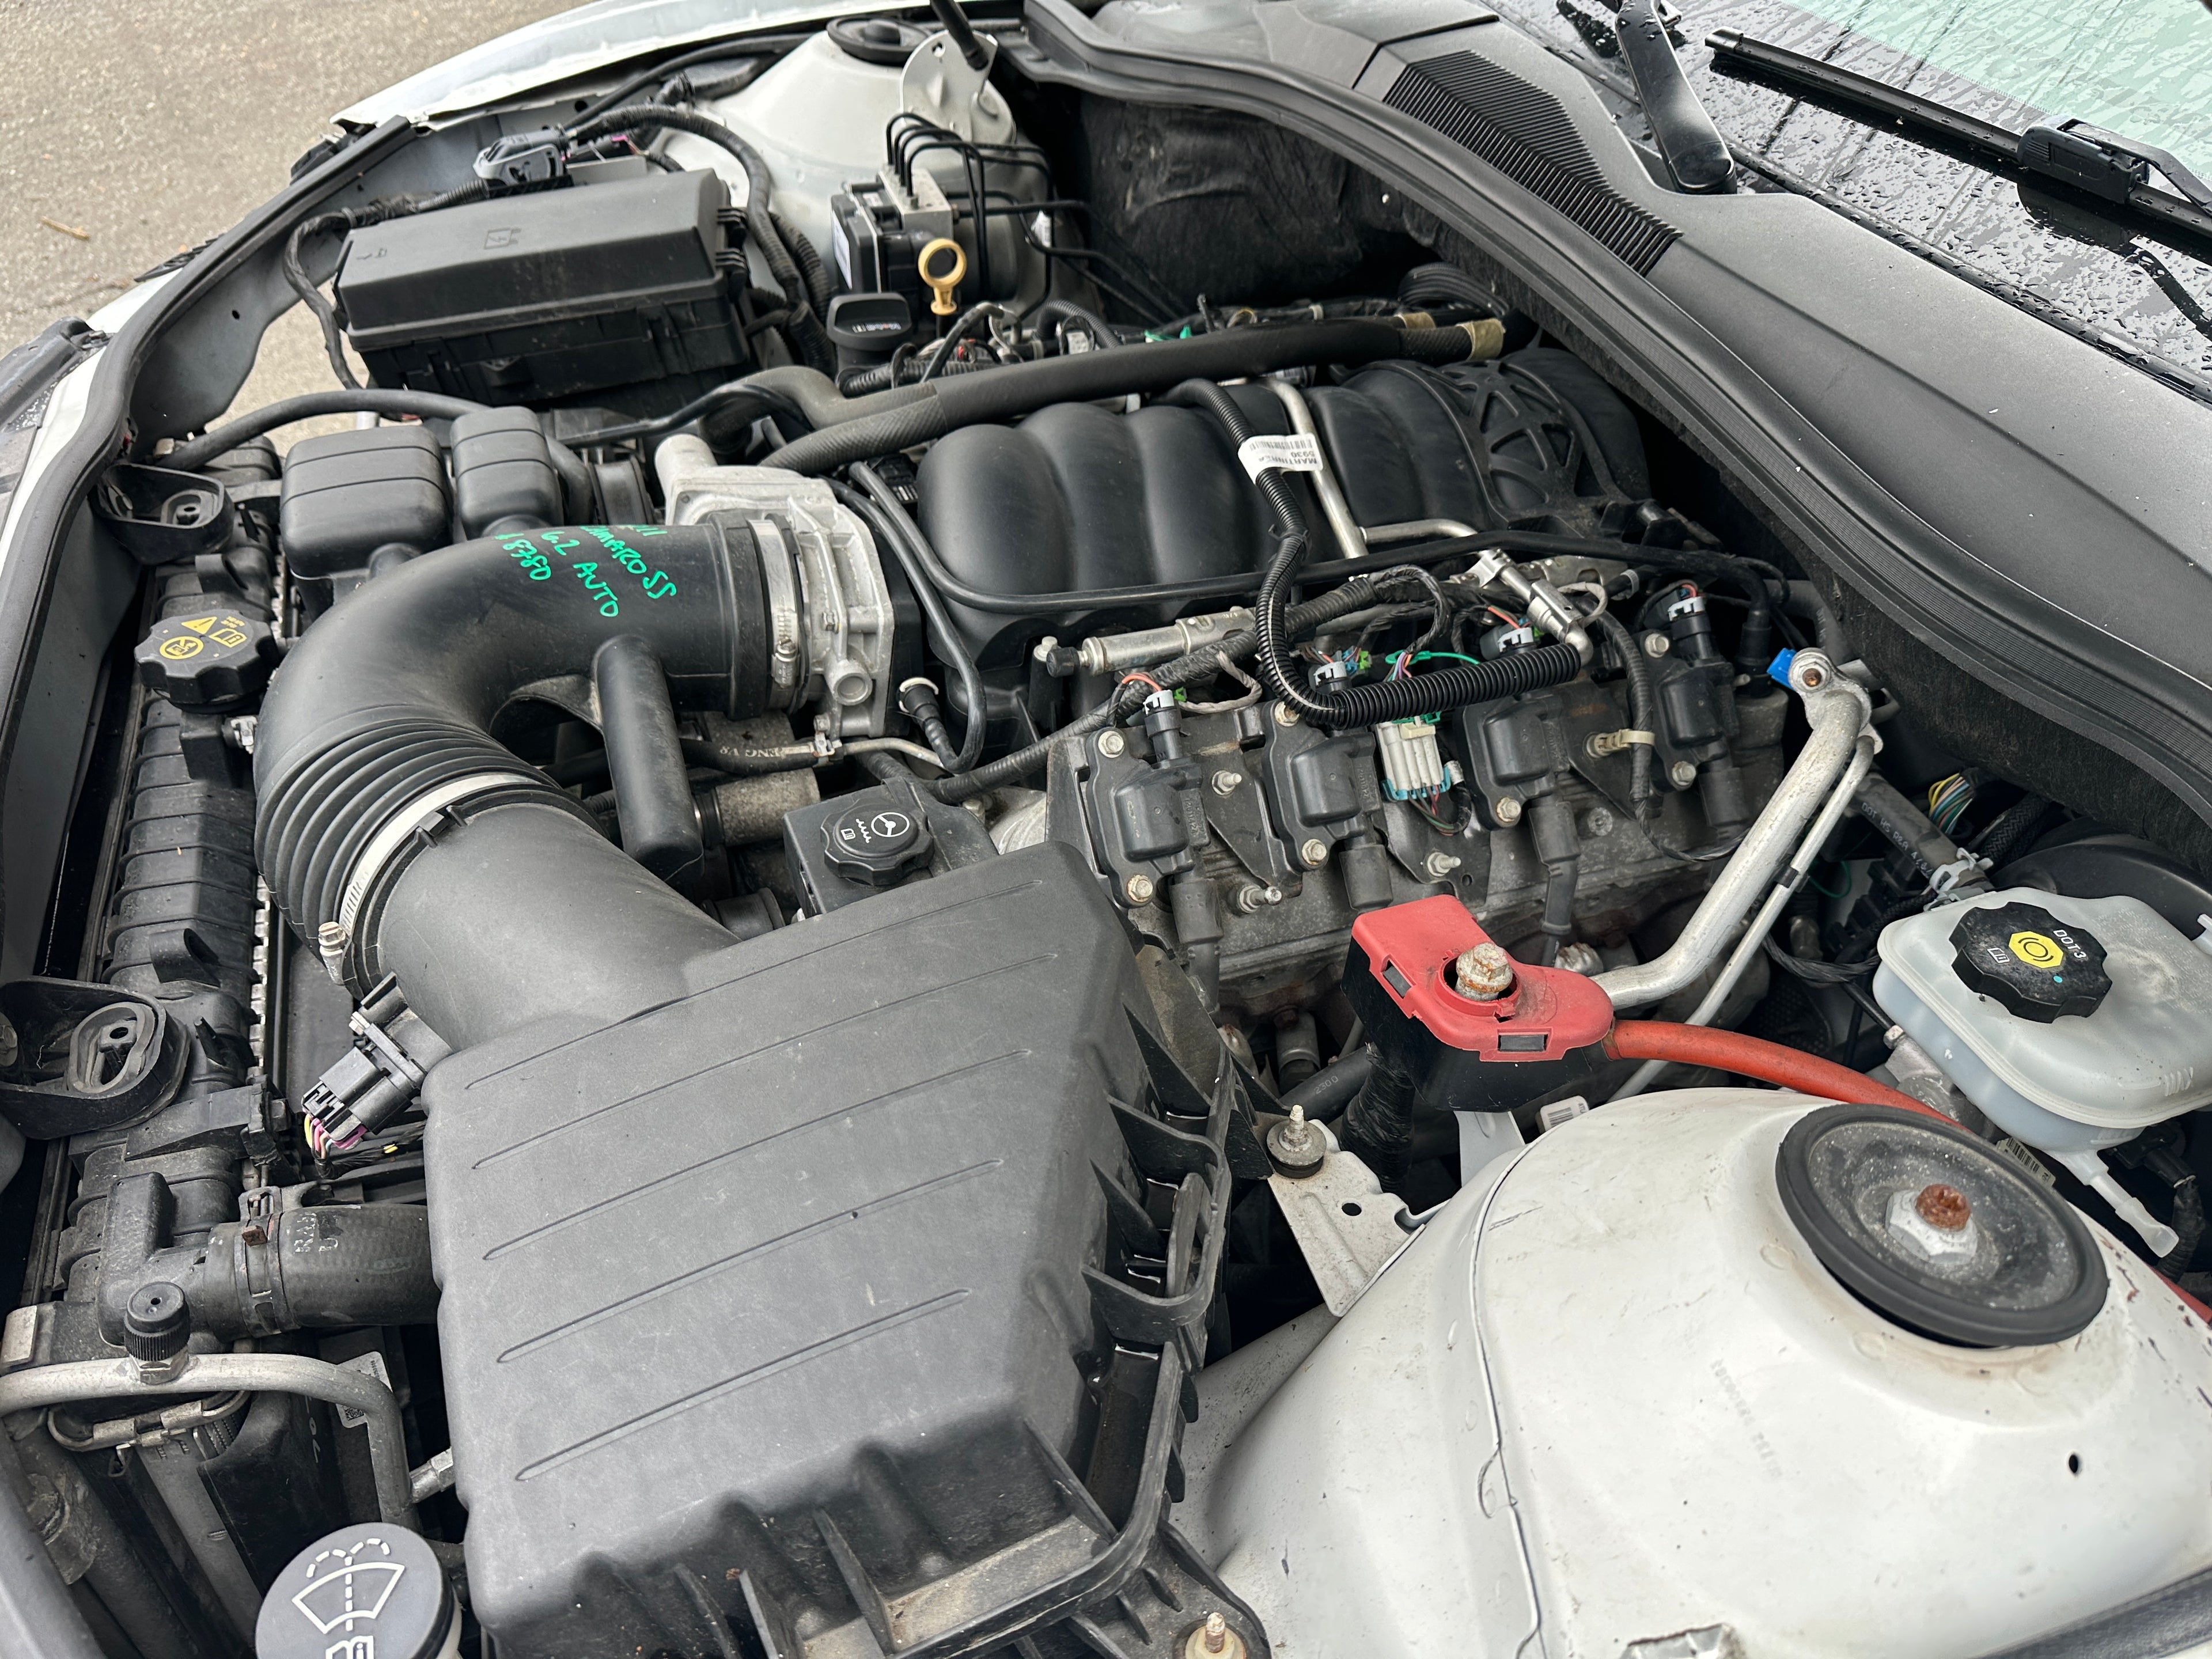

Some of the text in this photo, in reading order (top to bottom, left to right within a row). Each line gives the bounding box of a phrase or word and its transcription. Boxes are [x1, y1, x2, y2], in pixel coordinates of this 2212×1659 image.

[495, 533, 552, 581] 18780
[541, 531, 619, 618] 6.2 AUTO
[643, 570, 677, 599] SS
[719, 746, 781, 757] ENG V8
[2053, 929, 2086, 959] DOT 3
[1314, 1075, 1339, 1094] 2300
